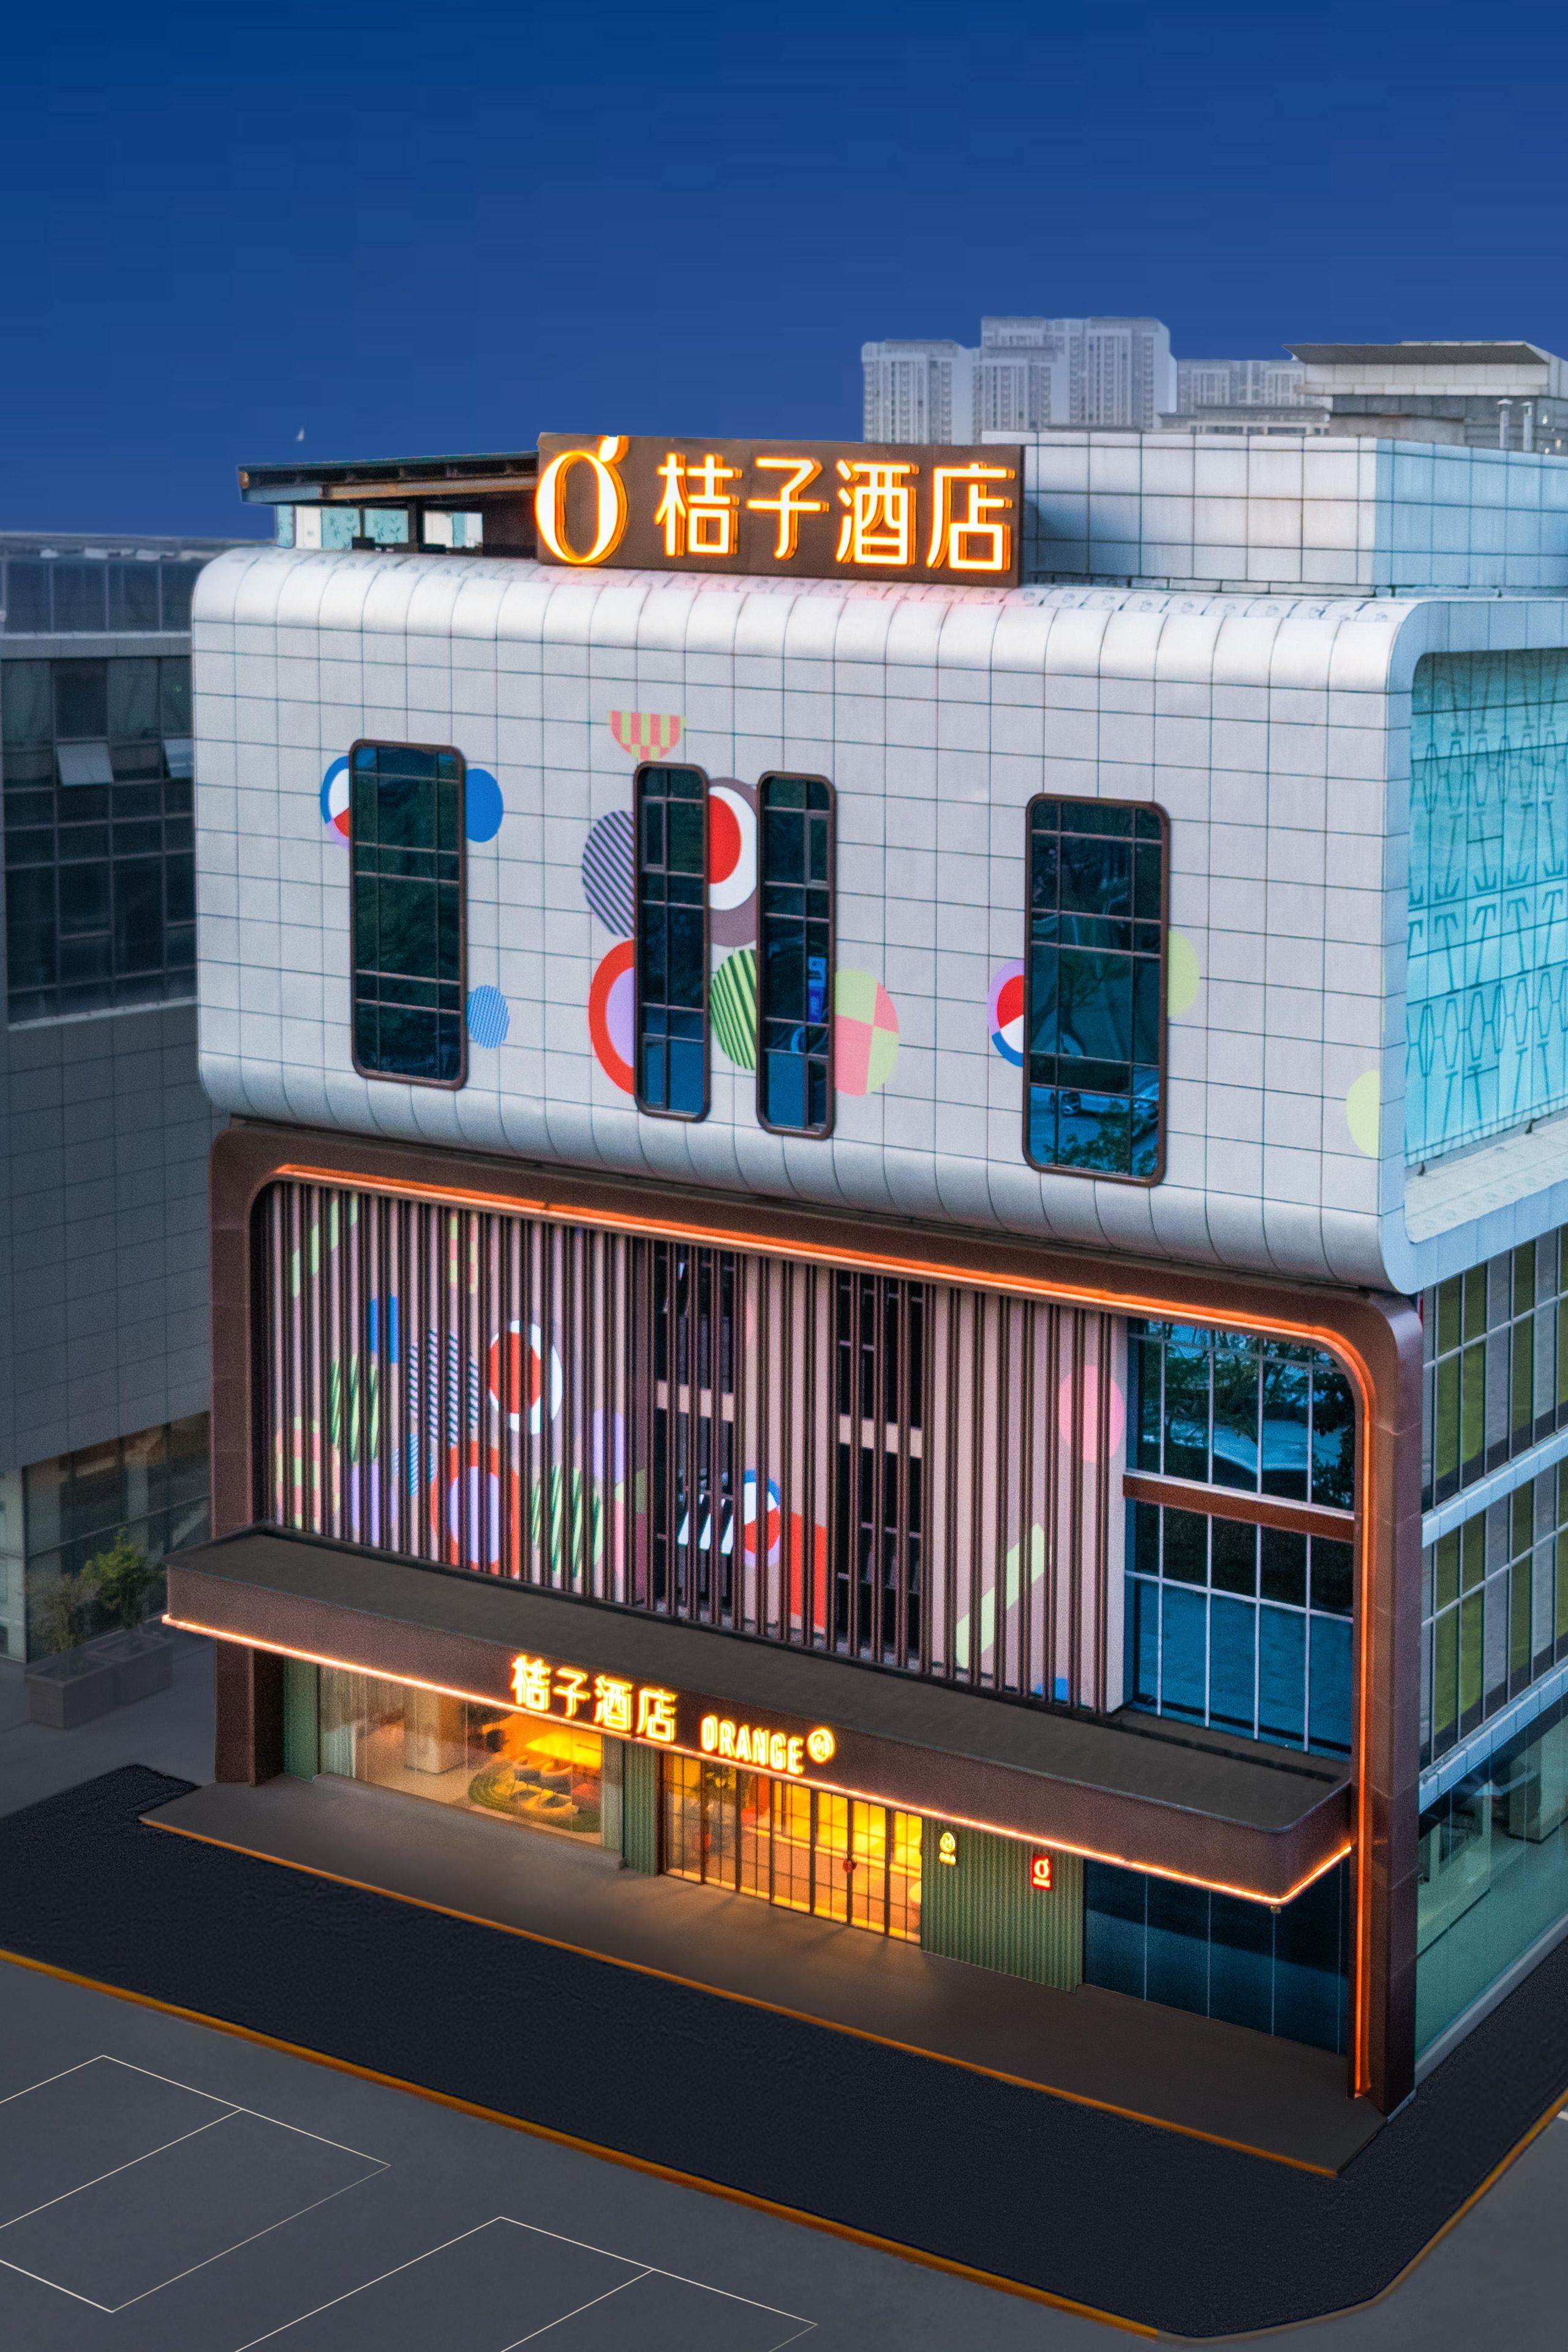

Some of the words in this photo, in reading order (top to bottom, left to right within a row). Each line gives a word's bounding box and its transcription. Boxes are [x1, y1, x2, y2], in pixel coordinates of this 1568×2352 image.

[656, 453, 1014, 571] 桔子酒店
[511, 1655, 677, 1742] 桔子酒店
[701, 1716, 804, 1774] ORANGE
